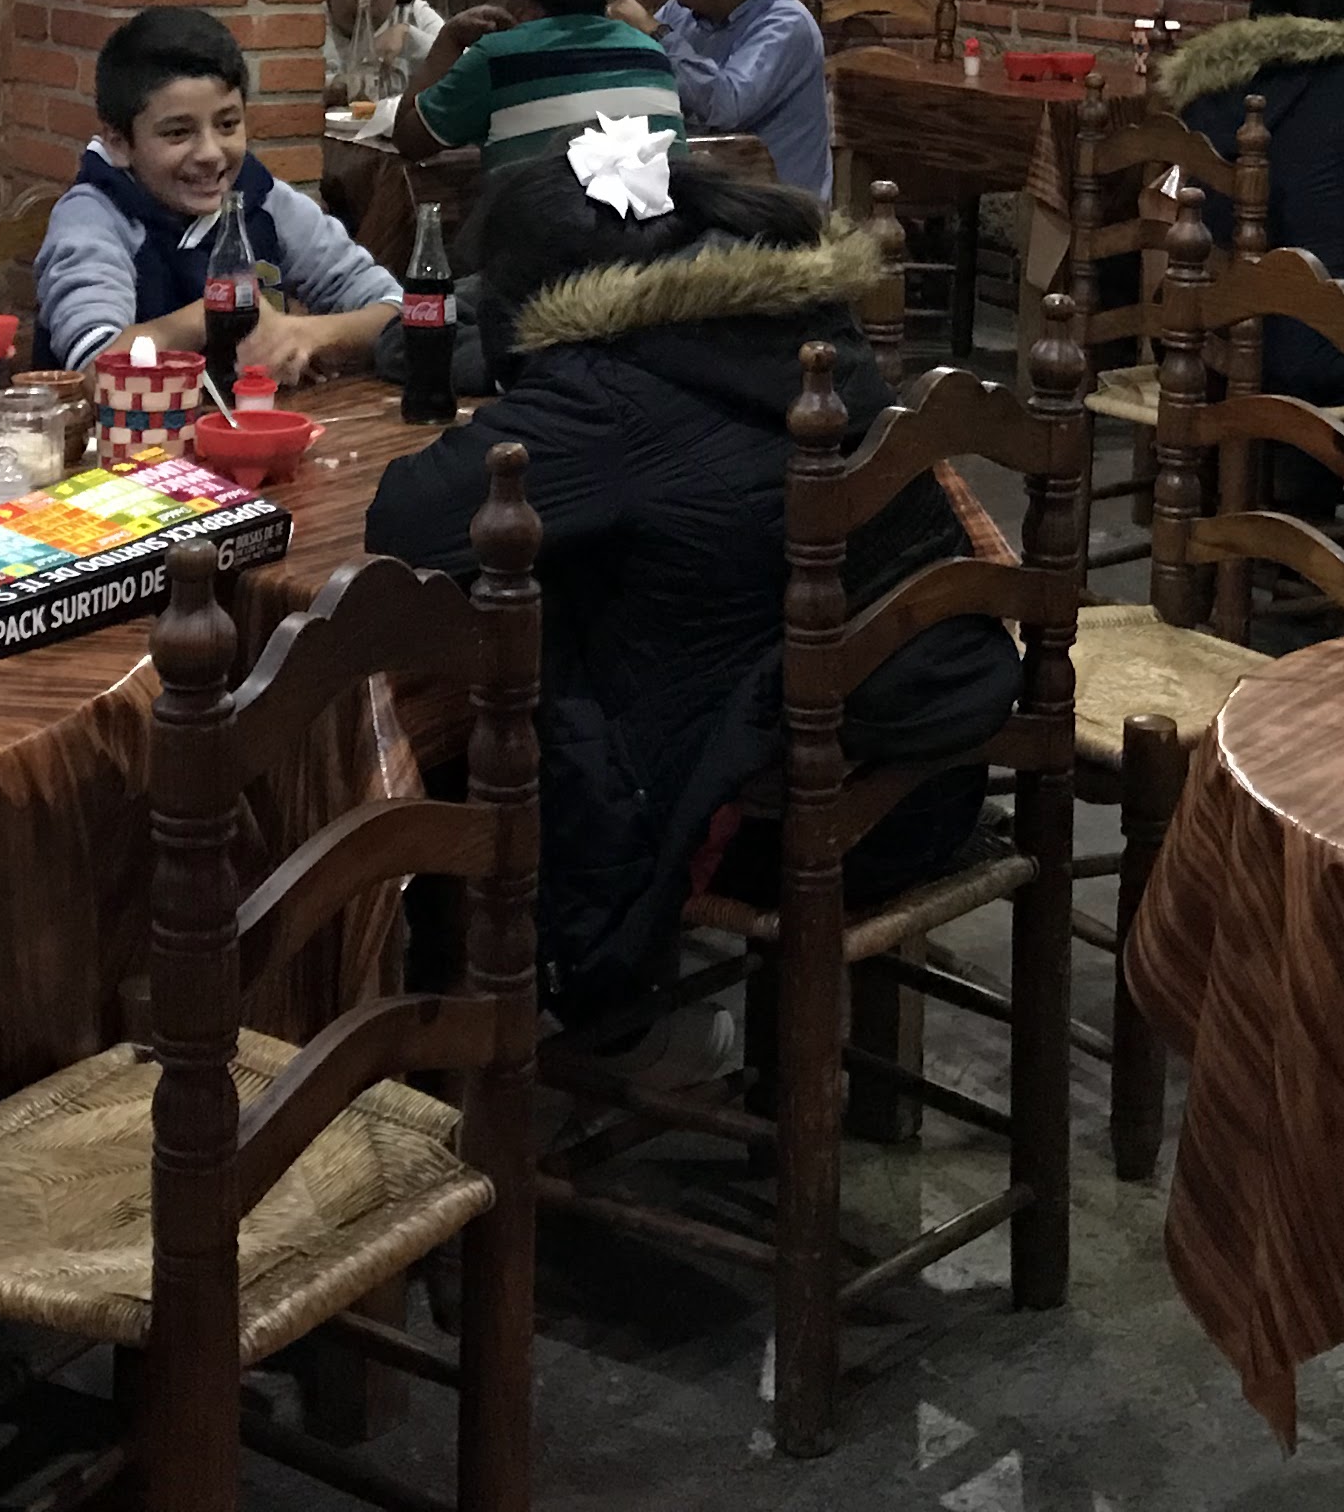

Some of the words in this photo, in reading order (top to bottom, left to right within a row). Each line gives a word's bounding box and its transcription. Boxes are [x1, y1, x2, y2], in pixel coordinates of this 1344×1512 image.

[161, 499, 277, 544] SUPERPACK
[43, 566, 81, 584] DE
[73, 536, 170, 574] SURTIDO
[50, 575, 137, 630] SURTIDO
[140, 564, 167, 599] DE
[217, 538, 235, 571] 6
